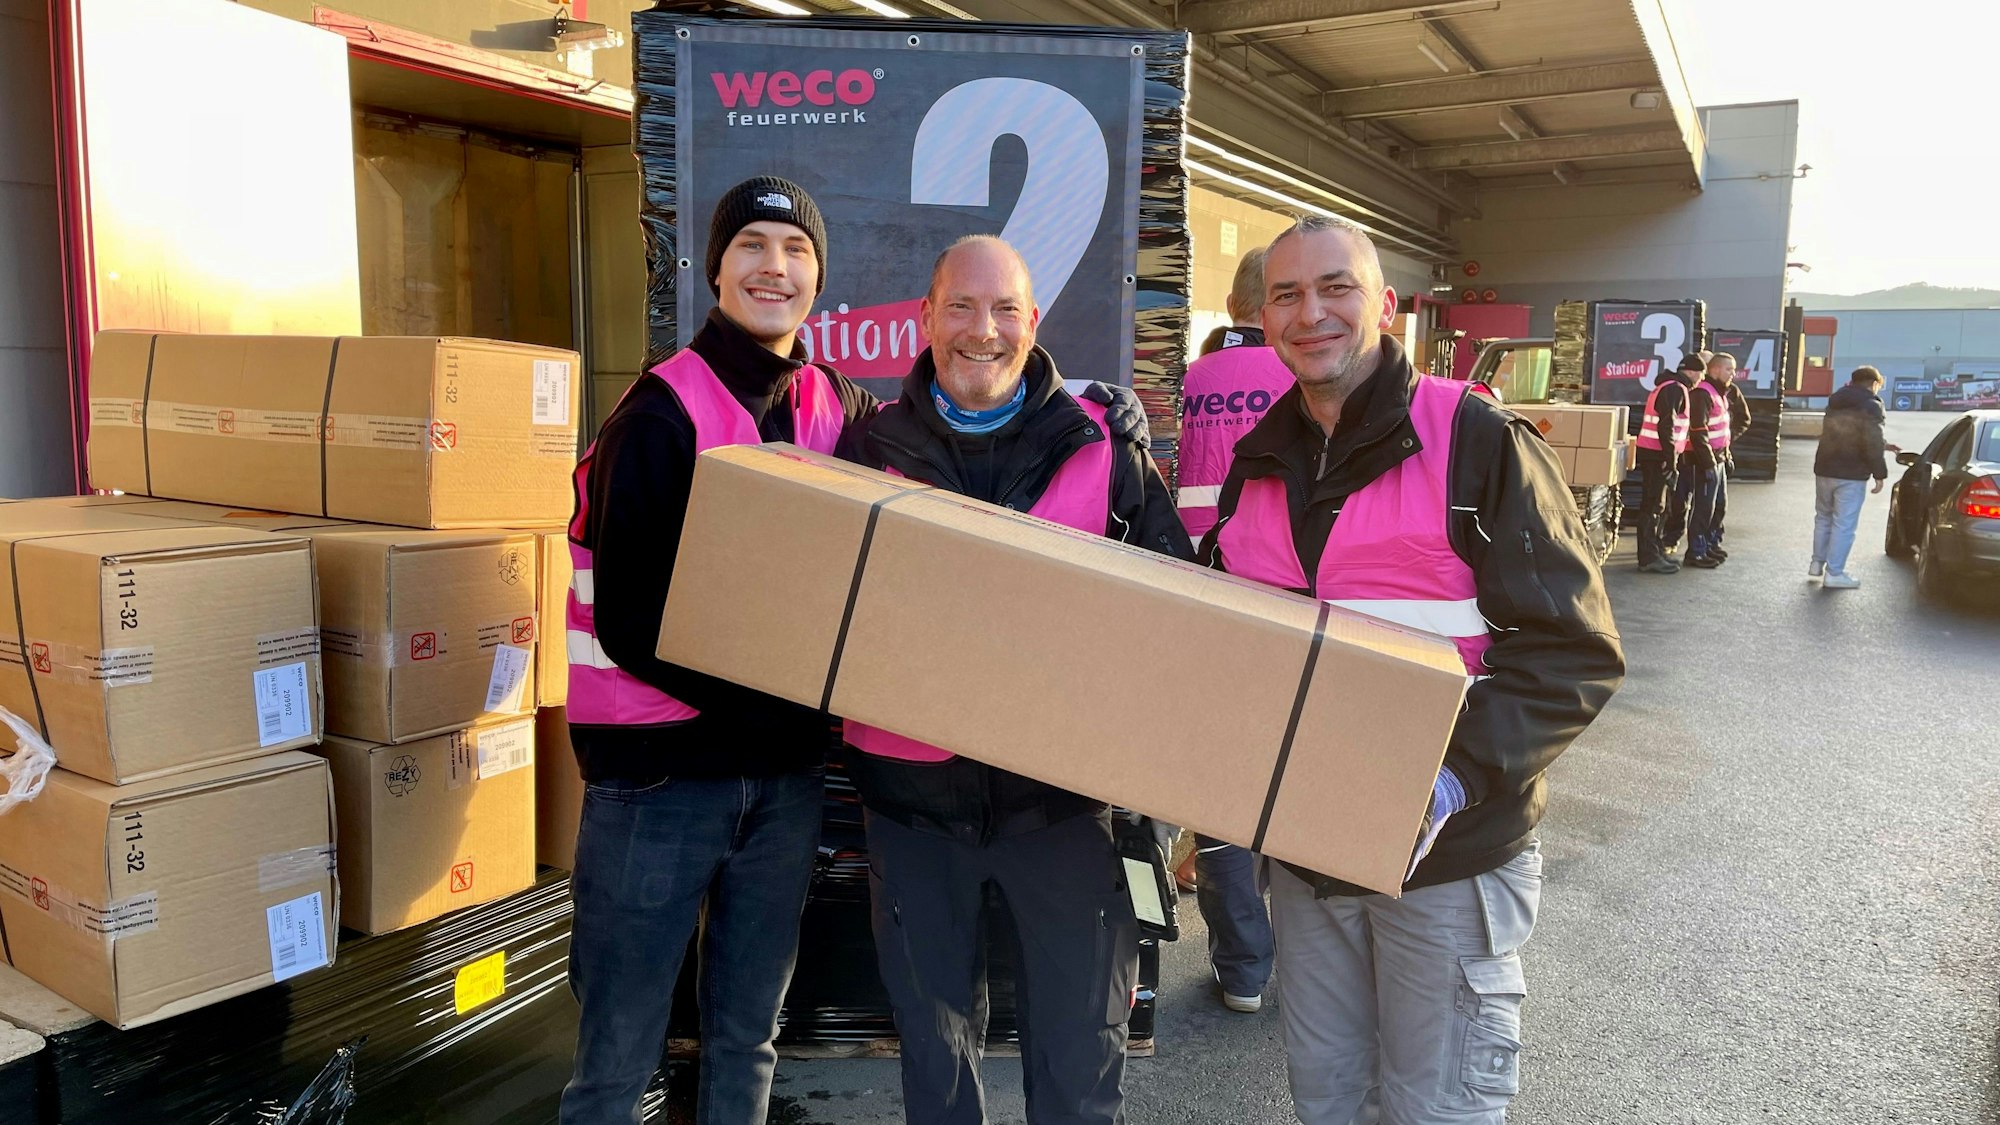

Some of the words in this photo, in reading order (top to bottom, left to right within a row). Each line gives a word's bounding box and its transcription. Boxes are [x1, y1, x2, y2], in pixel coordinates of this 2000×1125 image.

[727, 108, 867, 127] feuerwerk
[910, 77, 1110, 396] 2
[797, 303, 917, 363] ation
[1639, 313, 1685, 392] 3
[1744, 339, 1776, 390] 4
[443, 353, 459, 404] 111-32
[1606, 361, 1645, 377] Station
[1187, 415, 1262, 430] euerwerk
[117, 568, 138, 630] 111-32
[506, 669, 516, 693] 209902
[283, 690, 292, 716] 209902
[388, 766, 416, 782] REZY
[124, 811, 145, 874] 111-32
[284, 906, 292, 915] UN
[298, 920, 308, 947] 209902
